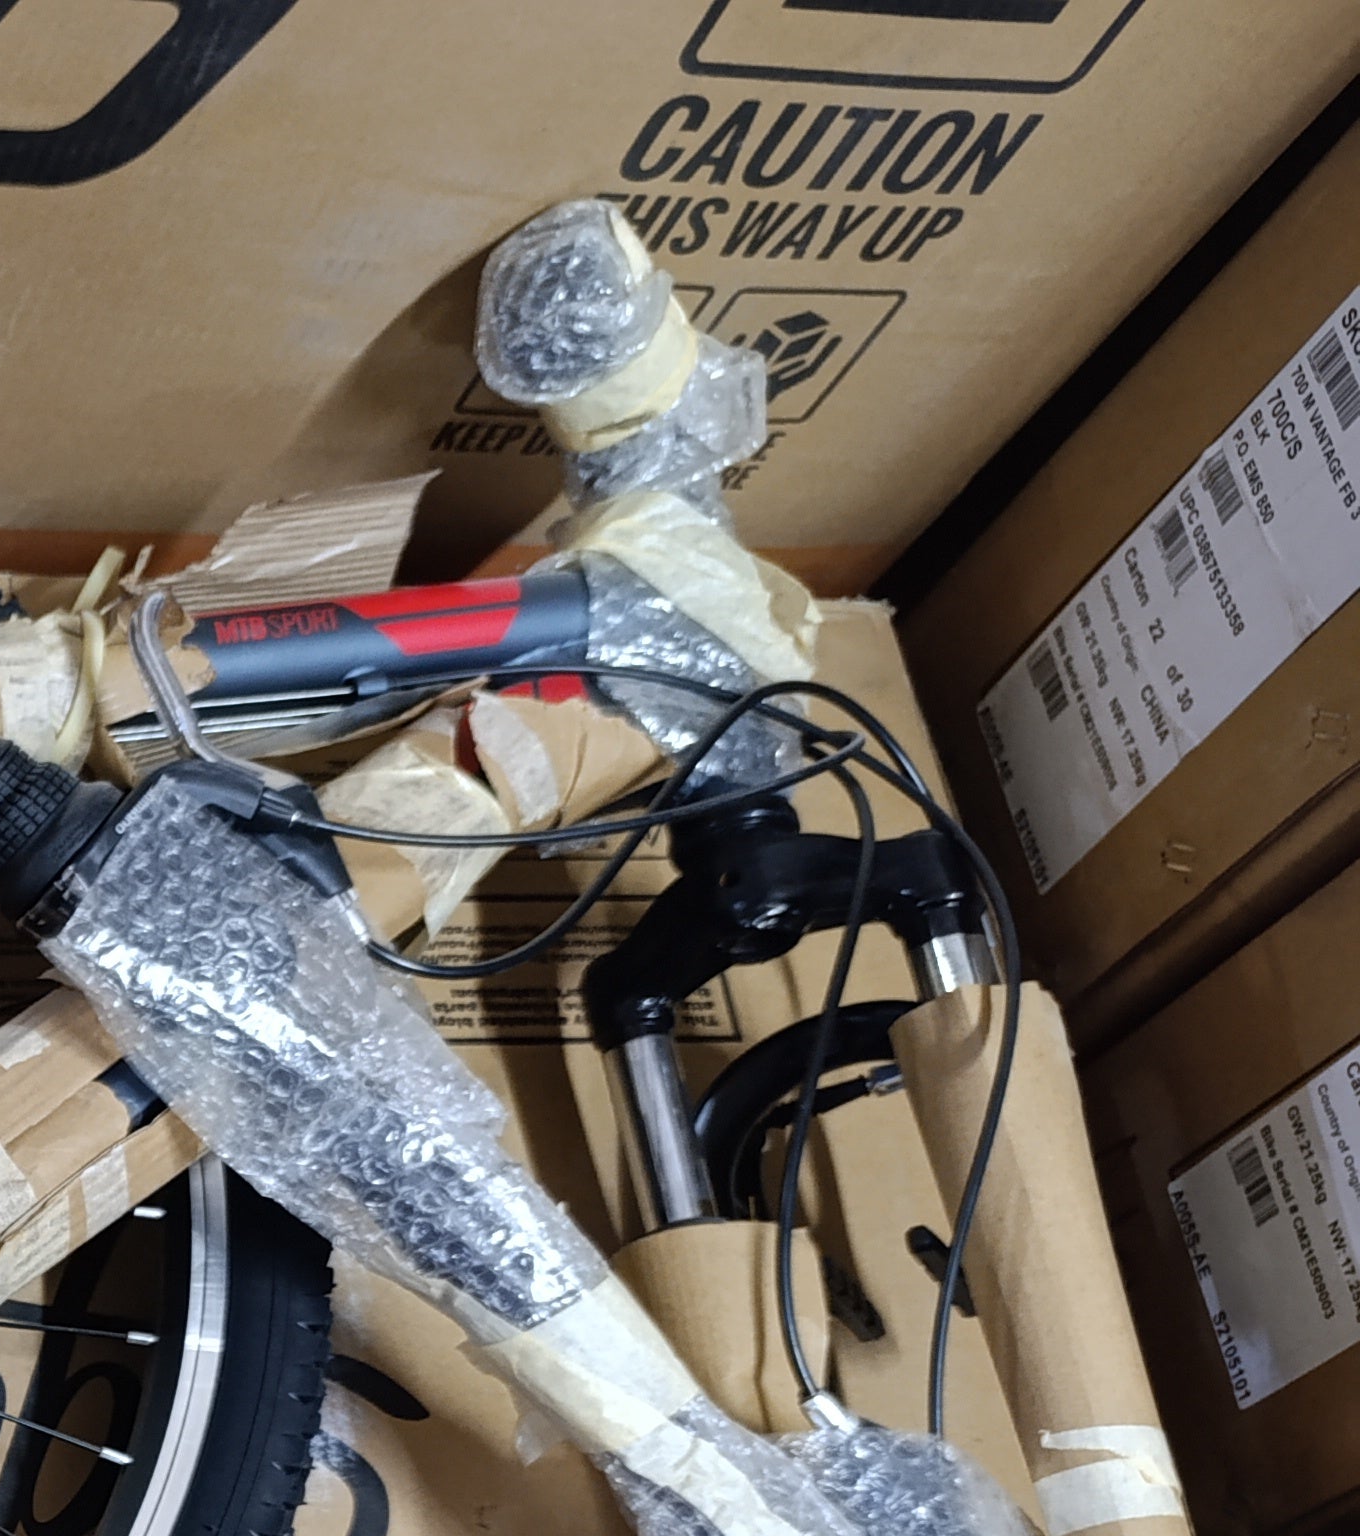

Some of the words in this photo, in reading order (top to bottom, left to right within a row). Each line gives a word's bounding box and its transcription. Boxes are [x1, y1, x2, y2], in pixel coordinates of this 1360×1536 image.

[619, 95, 1044, 195] CAUTION
[721, 202, 871, 264] WAY
[860, 206, 965, 264] UP
[429, 420, 530, 456] KEEP
[1250, 408, 1271, 446] BLK
[1266, 388, 1303, 461] 700C/S
[1290, 363, 1310, 396] 700
[1301, 391, 1316, 412] M
[1309, 408, 1347, 486] VANTAGE
[1338, 480, 1358, 509] FB
[1179, 485, 1200, 526] UPC
[1243, 458, 1264, 497] EMS
[1256, 493, 1275, 525] 850
[214, 615, 267, 645] MTB
[266, 607, 348, 639] SPORT
[1123, 546, 1150, 608] Carton
[1148, 617, 1166, 644] 22
[1166, 664, 1184, 686] of
[1176, 687, 1194, 714] 30
[1141, 683, 1170, 747] CHINA
[1316, 1083, 1342, 1138] Country
[1336, 1138, 1351, 1155] of
[1260, 1124, 1277, 1159] Bike
[1272, 1156, 1295, 1203] Serial
[1213, 1310, 1251, 1402] S2105101
